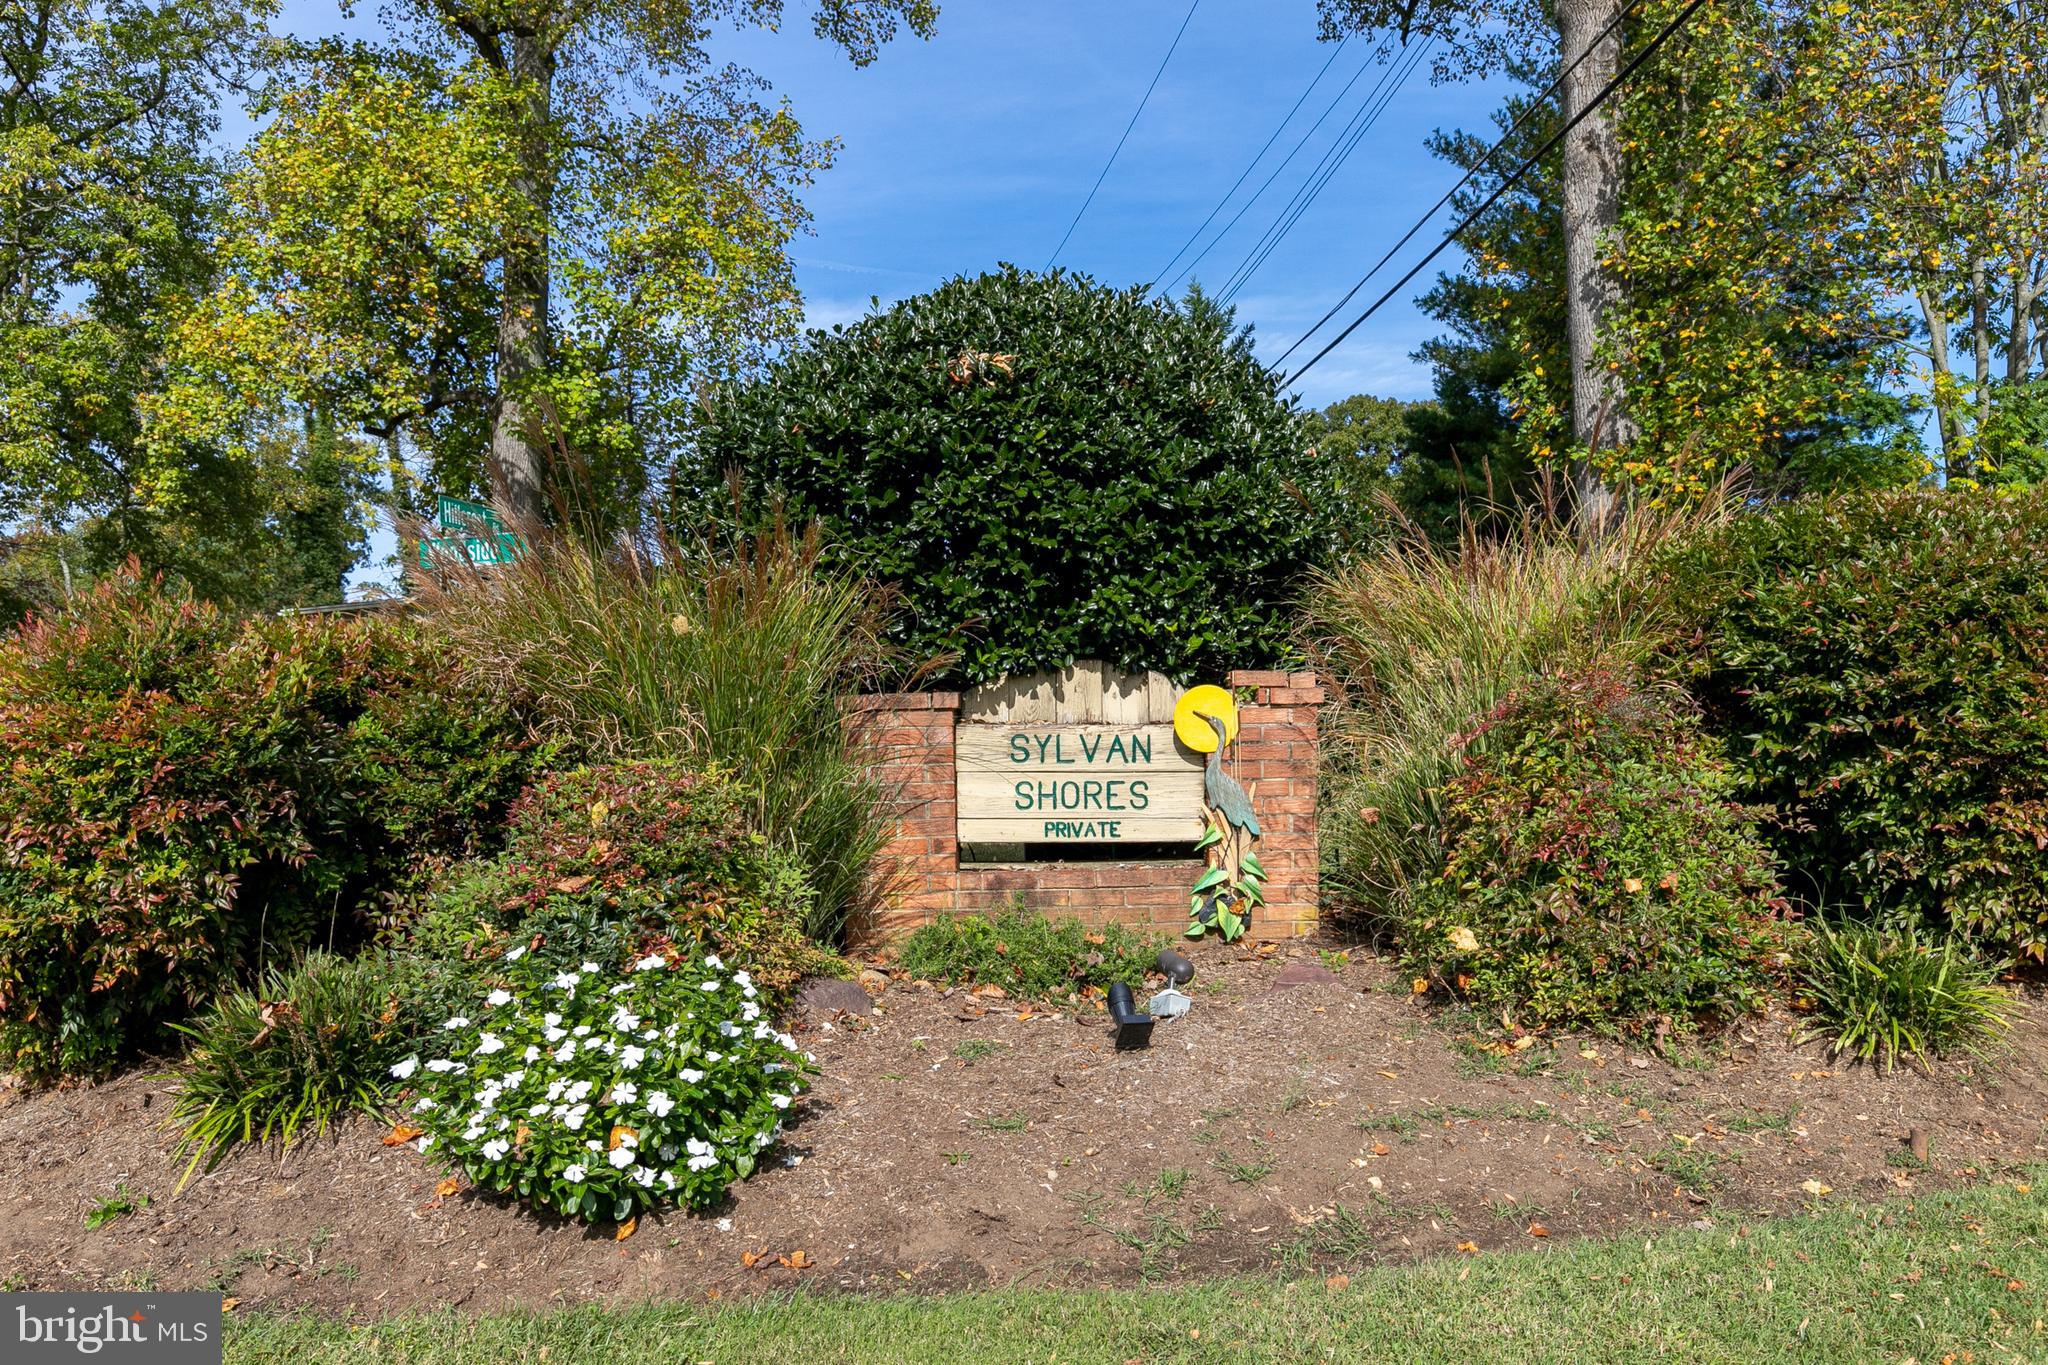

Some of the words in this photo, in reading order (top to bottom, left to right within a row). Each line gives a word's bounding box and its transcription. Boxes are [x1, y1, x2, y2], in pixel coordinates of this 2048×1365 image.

[1010, 734, 1152, 764] SYLVAN
[1014, 780, 1150, 810] SHORES
[1044, 821, 1122, 839] PRIVATE
